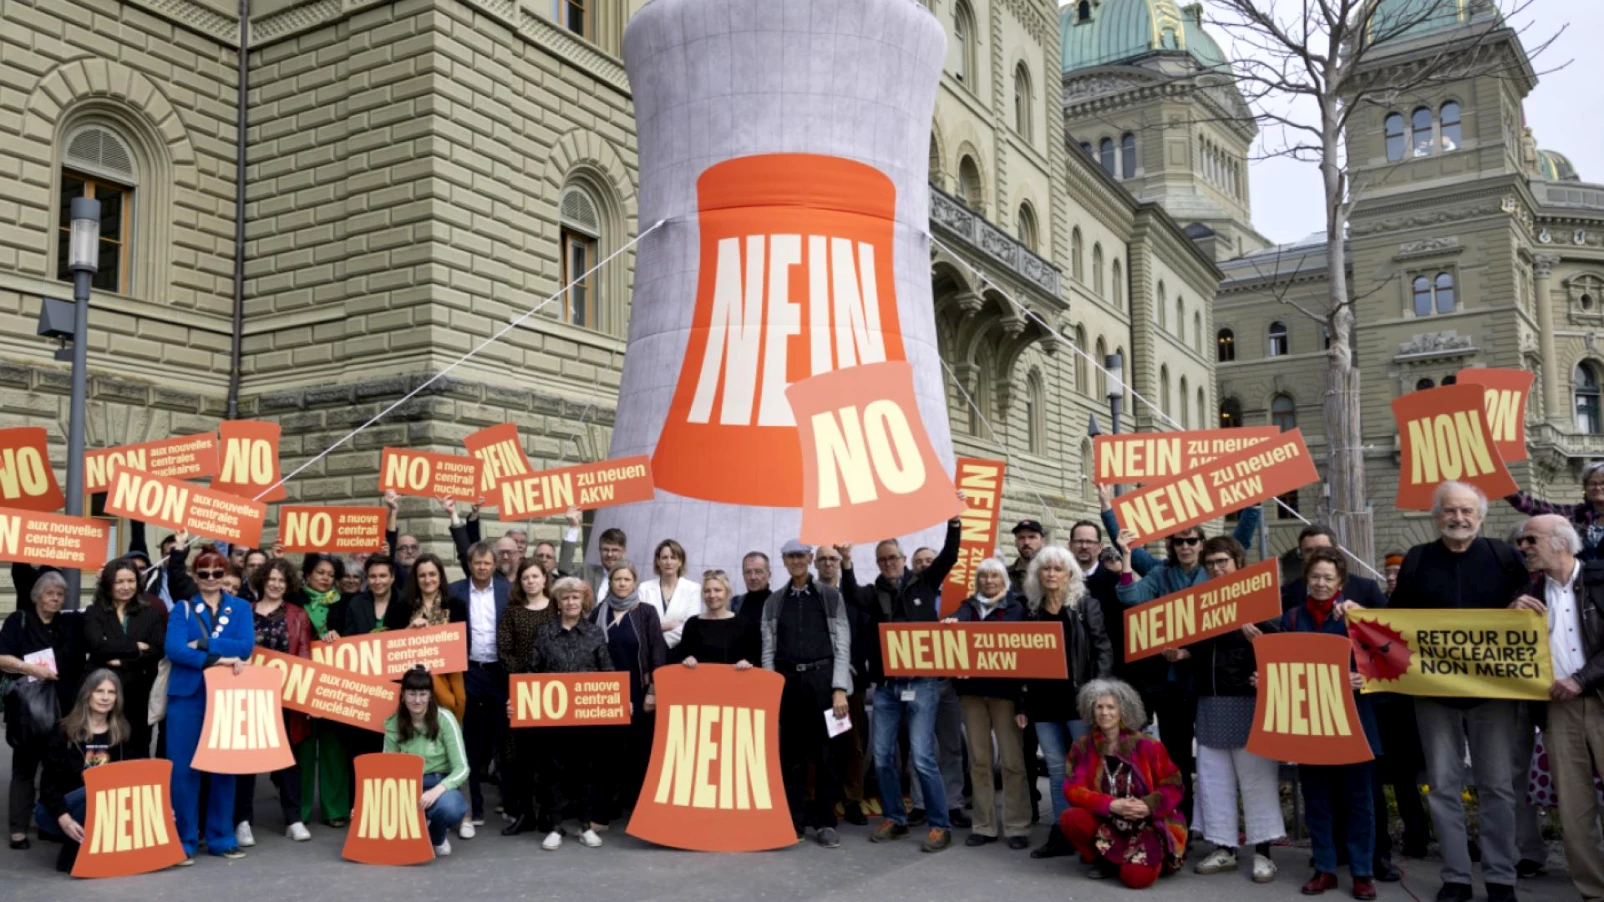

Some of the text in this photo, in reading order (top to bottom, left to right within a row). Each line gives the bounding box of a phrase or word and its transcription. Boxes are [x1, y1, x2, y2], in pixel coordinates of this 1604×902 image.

[686, 233, 887, 427] NEIN
[1485, 388, 1522, 442] ON
[150, 440, 212, 457] aux nouvelles
[811, 399, 926, 509] NO
[1100, 438, 1182, 478] NEIN
[1188, 440, 1209, 454] zu
[1408, 409, 1496, 485] NON
[150, 453, 195, 467] centrales
[219, 438, 274, 486] NO
[385, 453, 430, 491] NO
[436, 461, 475, 473] a nuove
[474, 439, 527, 492] NEIN
[1209, 466, 1235, 487] zu
[1235, 442, 1300, 477] neuen
[435, 472, 474, 485] centrali
[576, 464, 646, 487] zu neuen
[112, 472, 188, 524] NON
[433, 483, 475, 497] nucleari
[501, 472, 575, 516] NEIN
[580, 484, 614, 504] AKW
[1219, 475, 1264, 508] AKW
[190, 505, 239, 525] centrales
[192, 493, 260, 519] aux nouvelles
[959, 464, 998, 542] NEIN
[1119, 473, 1215, 539] NEIN
[27, 520, 103, 538] aux nouvelles
[187, 517, 241, 539] nucléaires
[284, 511, 333, 547] NO
[338, 525, 378, 535] centrali
[339, 515, 379, 523] a nuove
[25, 533, 80, 548] centrales
[336, 537, 380, 547] nucleari
[24, 546, 85, 562] nucléaires
[1200, 571, 1272, 610] zu neuen
[1129, 593, 1196, 655] NEIN
[1202, 602, 1237, 632] AKW
[387, 630, 459, 649] aux nouvelles
[886, 630, 970, 670] NEIN
[973, 633, 1057, 649] zu neuen
[1416, 630, 1538, 646] RETOUR DU
[387, 646, 439, 661] centrales
[976, 652, 1017, 670] AKW
[1421, 660, 1539, 679] NON MERCI
[315, 685, 369, 708] centrales
[319, 672, 394, 700] aux nouvelles
[574, 681, 620, 692] a nuove
[574, 692, 621, 705] centrali
[1263, 662, 1351, 735] NEIN
[311, 698, 371, 722] nucléaires
[516, 680, 568, 720] NO
[574, 706, 624, 719] nucleari
[208, 689, 280, 749] NEIN
[654, 704, 773, 809] NEIN
[89, 784, 169, 854] NEIN
[358, 778, 421, 840] NON
